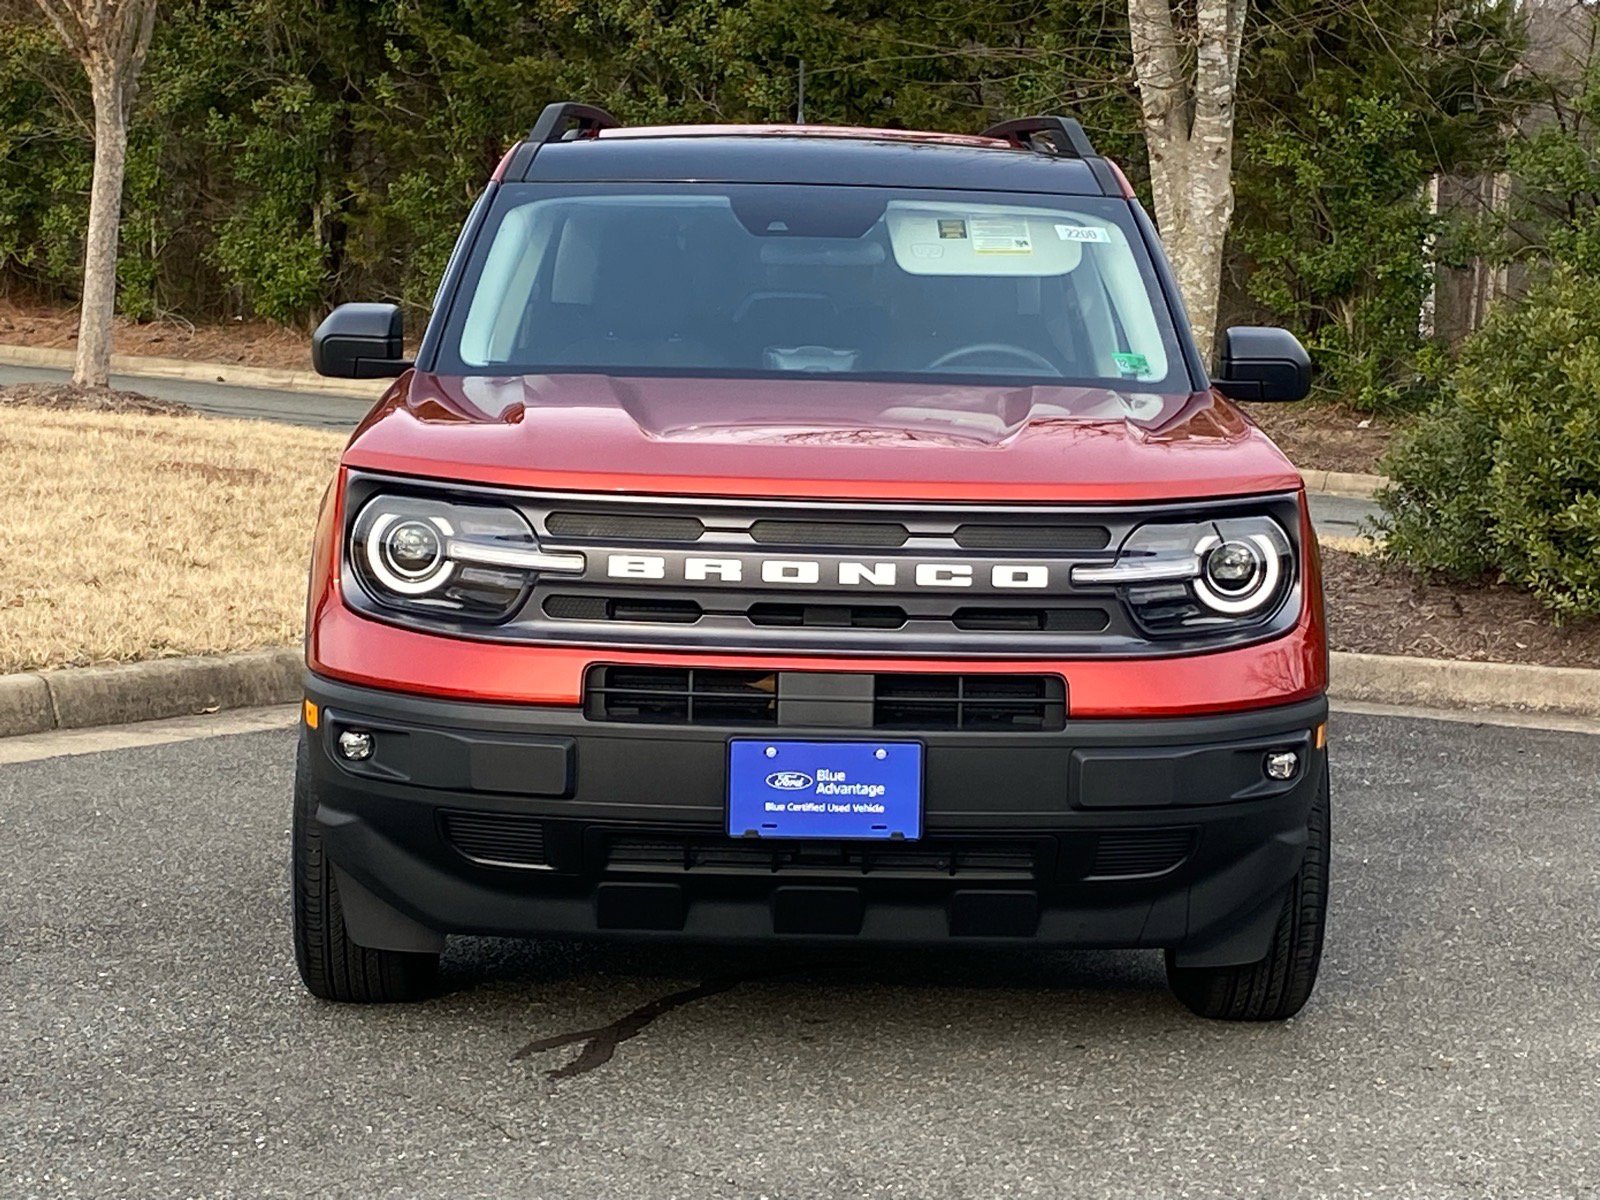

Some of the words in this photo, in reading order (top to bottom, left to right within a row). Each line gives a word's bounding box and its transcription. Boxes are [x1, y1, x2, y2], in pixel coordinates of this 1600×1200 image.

[1064, 228, 1098, 240] 2200
[607, 554, 1049, 588] BRONCO
[774, 773, 805, 787] Ford
[816, 769, 846, 782] Blue
[815, 782, 886, 797] Advantage
[764, 802, 786, 812] Blue
[786, 802, 826, 813] Certified
[827, 803, 851, 813] Used
[852, 803, 885, 814] Vehicle
